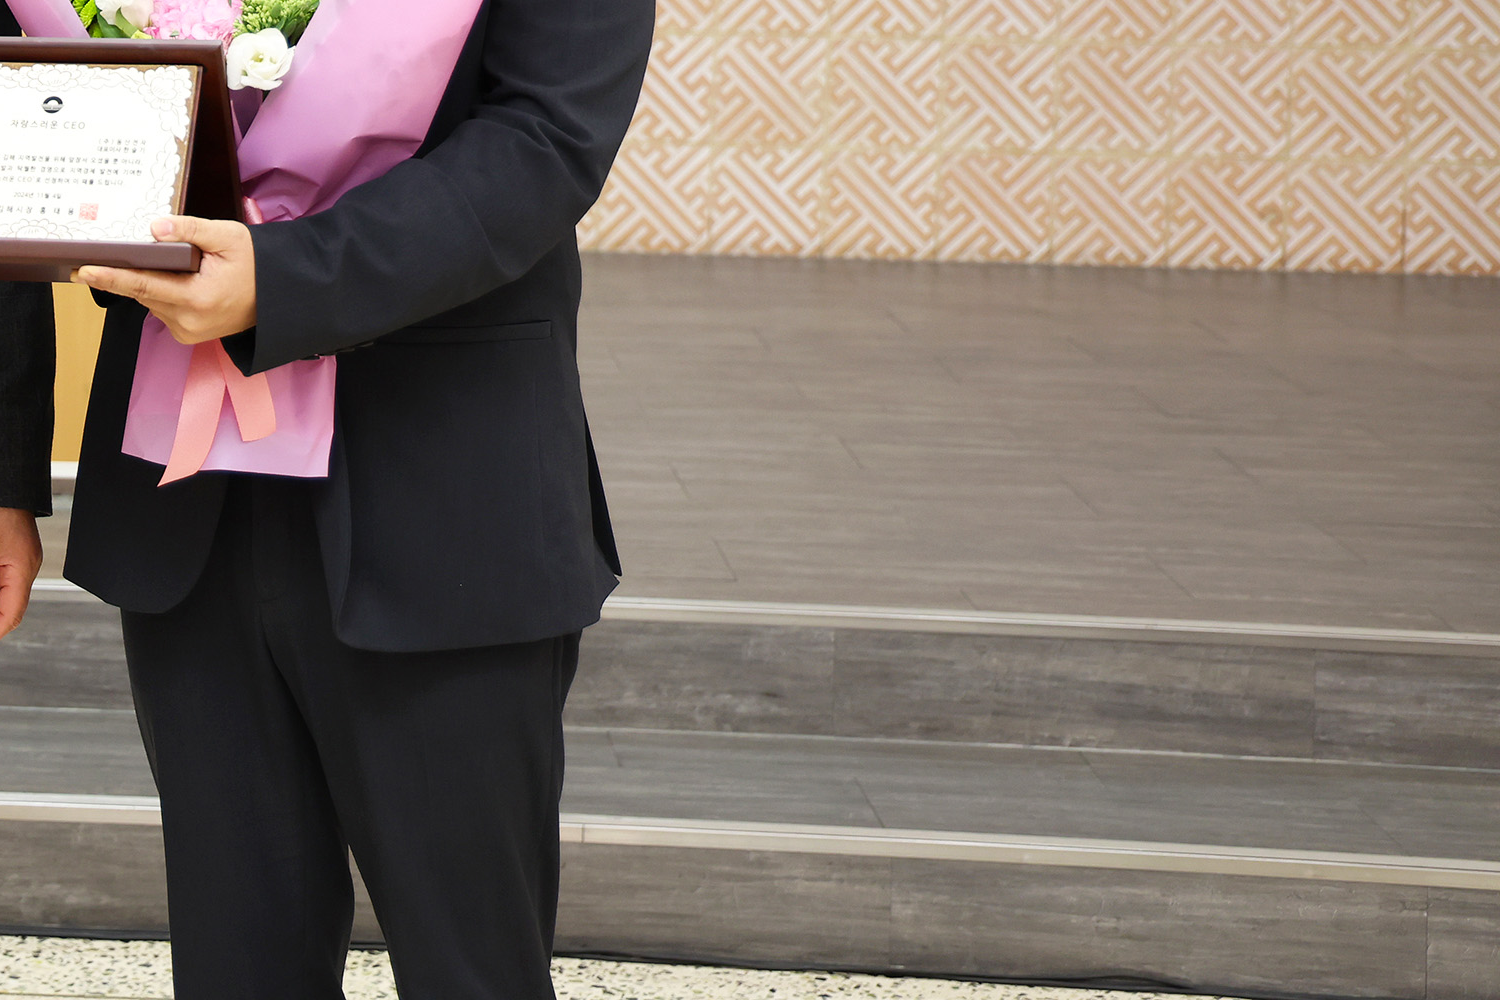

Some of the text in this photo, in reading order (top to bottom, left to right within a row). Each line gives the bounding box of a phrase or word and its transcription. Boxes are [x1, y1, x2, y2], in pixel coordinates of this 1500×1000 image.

[10, 119, 86, 130] 자랑스러운 CEO
[18, 154, 50, 162] 지역발전을
[13, 191, 34, 199] 2024년
